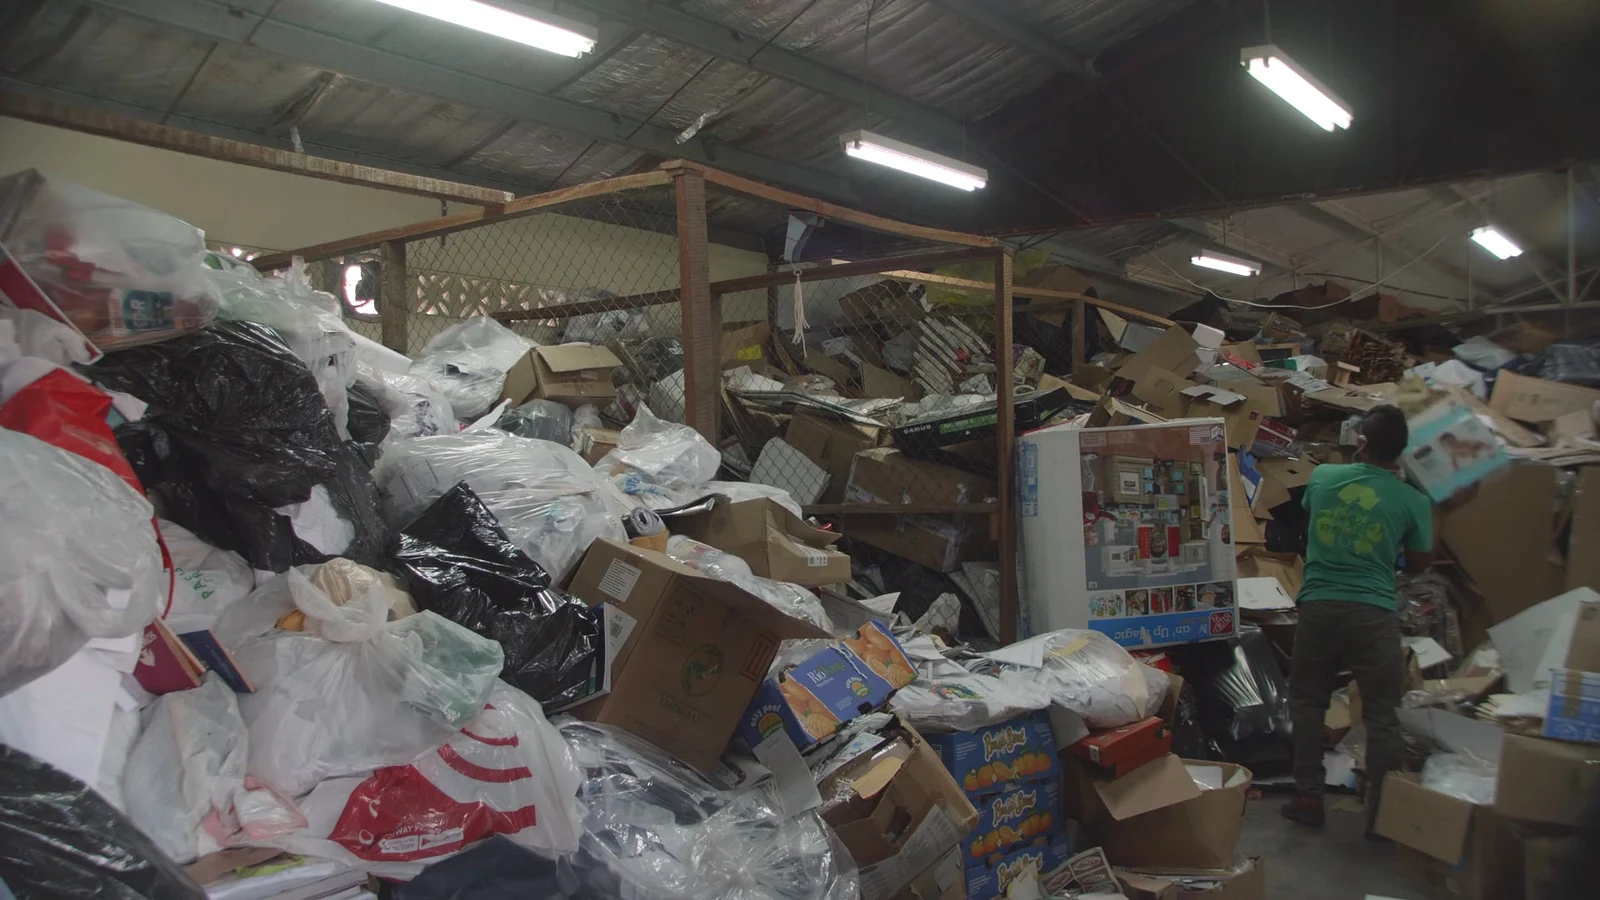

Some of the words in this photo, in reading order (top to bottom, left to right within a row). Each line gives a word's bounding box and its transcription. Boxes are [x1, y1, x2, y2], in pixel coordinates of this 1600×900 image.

[1154, 626, 1169, 638] Up
[750, 708, 763, 727] easy
[762, 704, 782, 714] peel
